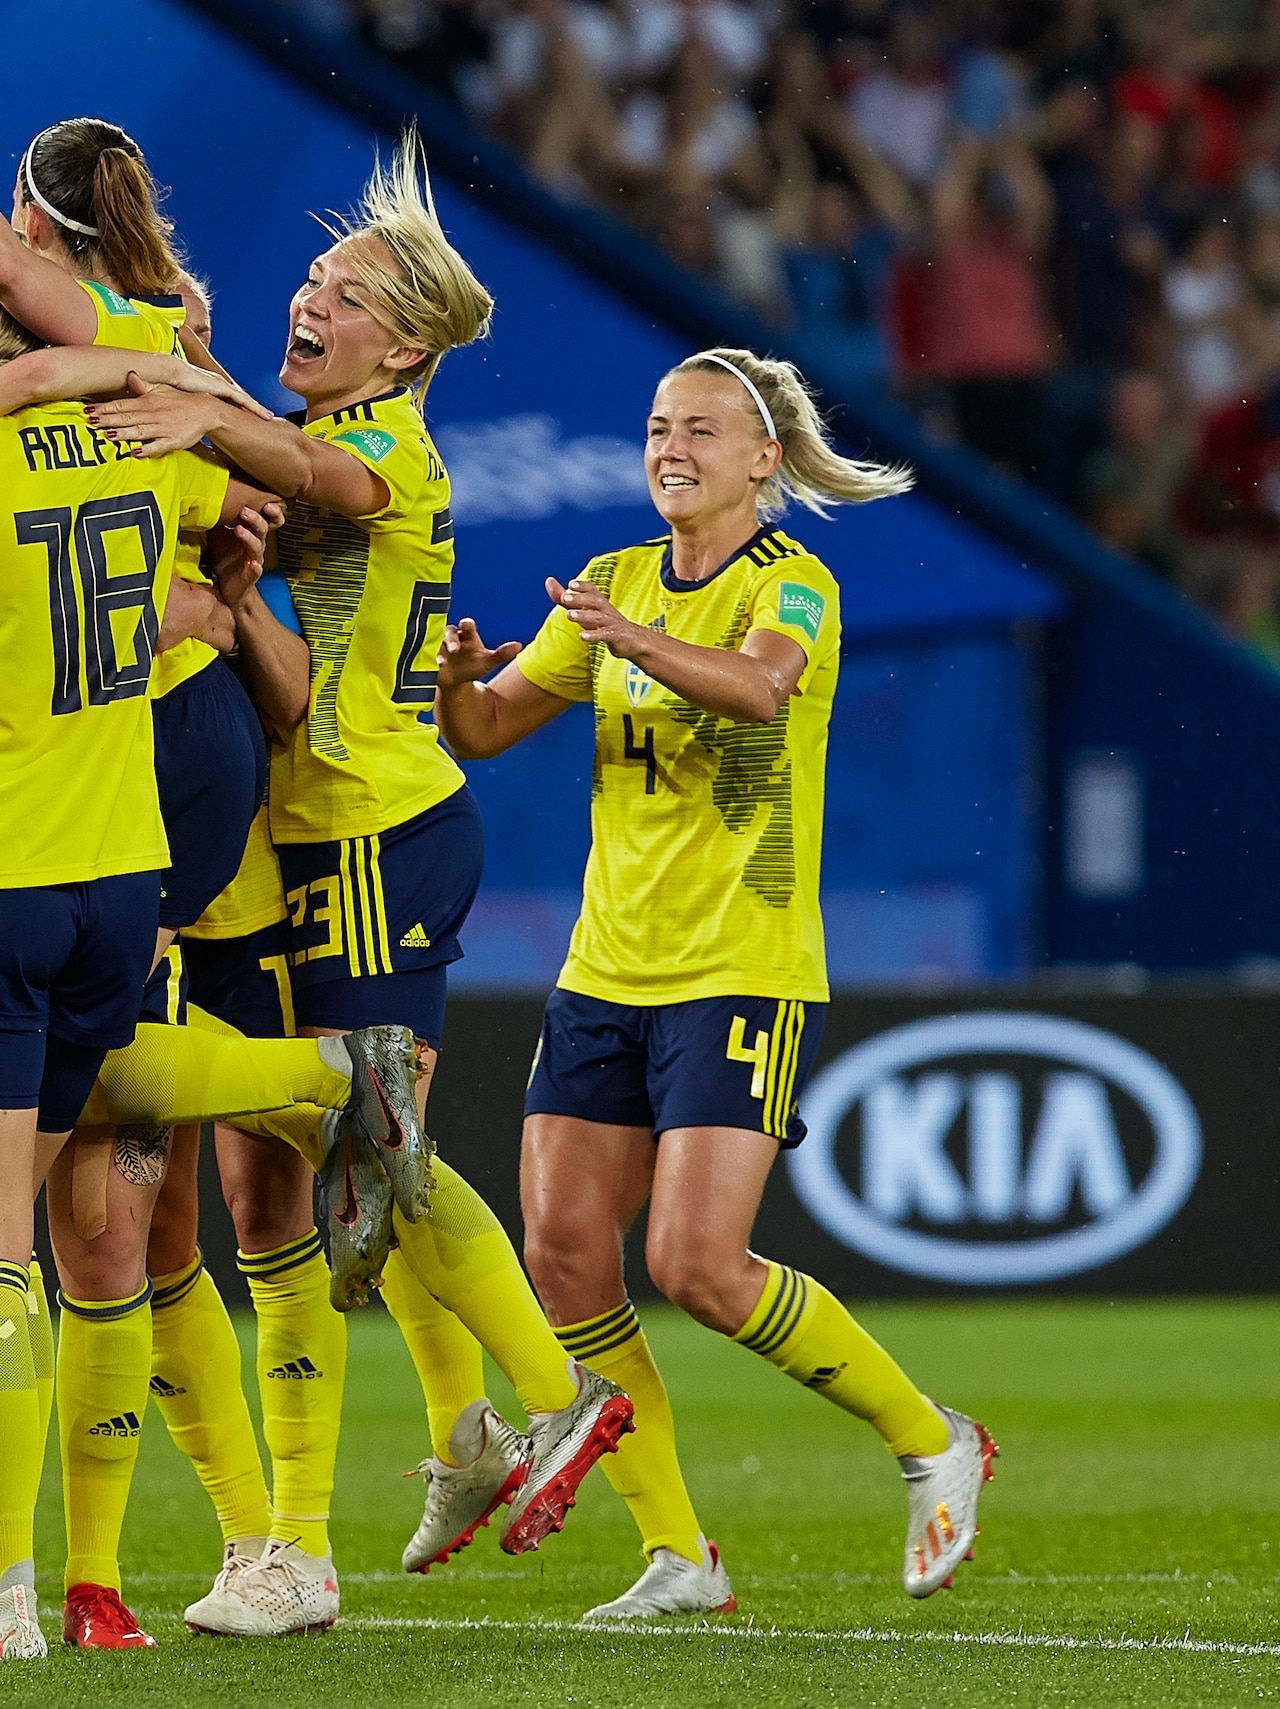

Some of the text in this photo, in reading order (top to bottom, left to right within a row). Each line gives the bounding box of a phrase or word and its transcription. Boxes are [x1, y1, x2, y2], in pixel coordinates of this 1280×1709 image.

[13, 490, 164, 716] 18
[622, 713, 656, 795] 4
[399, 939, 431, 948] adidas
[726, 1014, 769, 1099] 4
[861, 1071, 1134, 1223] KIA
[266, 1370, 324, 1380] adidas
[88, 1426, 141, 1438] adida
